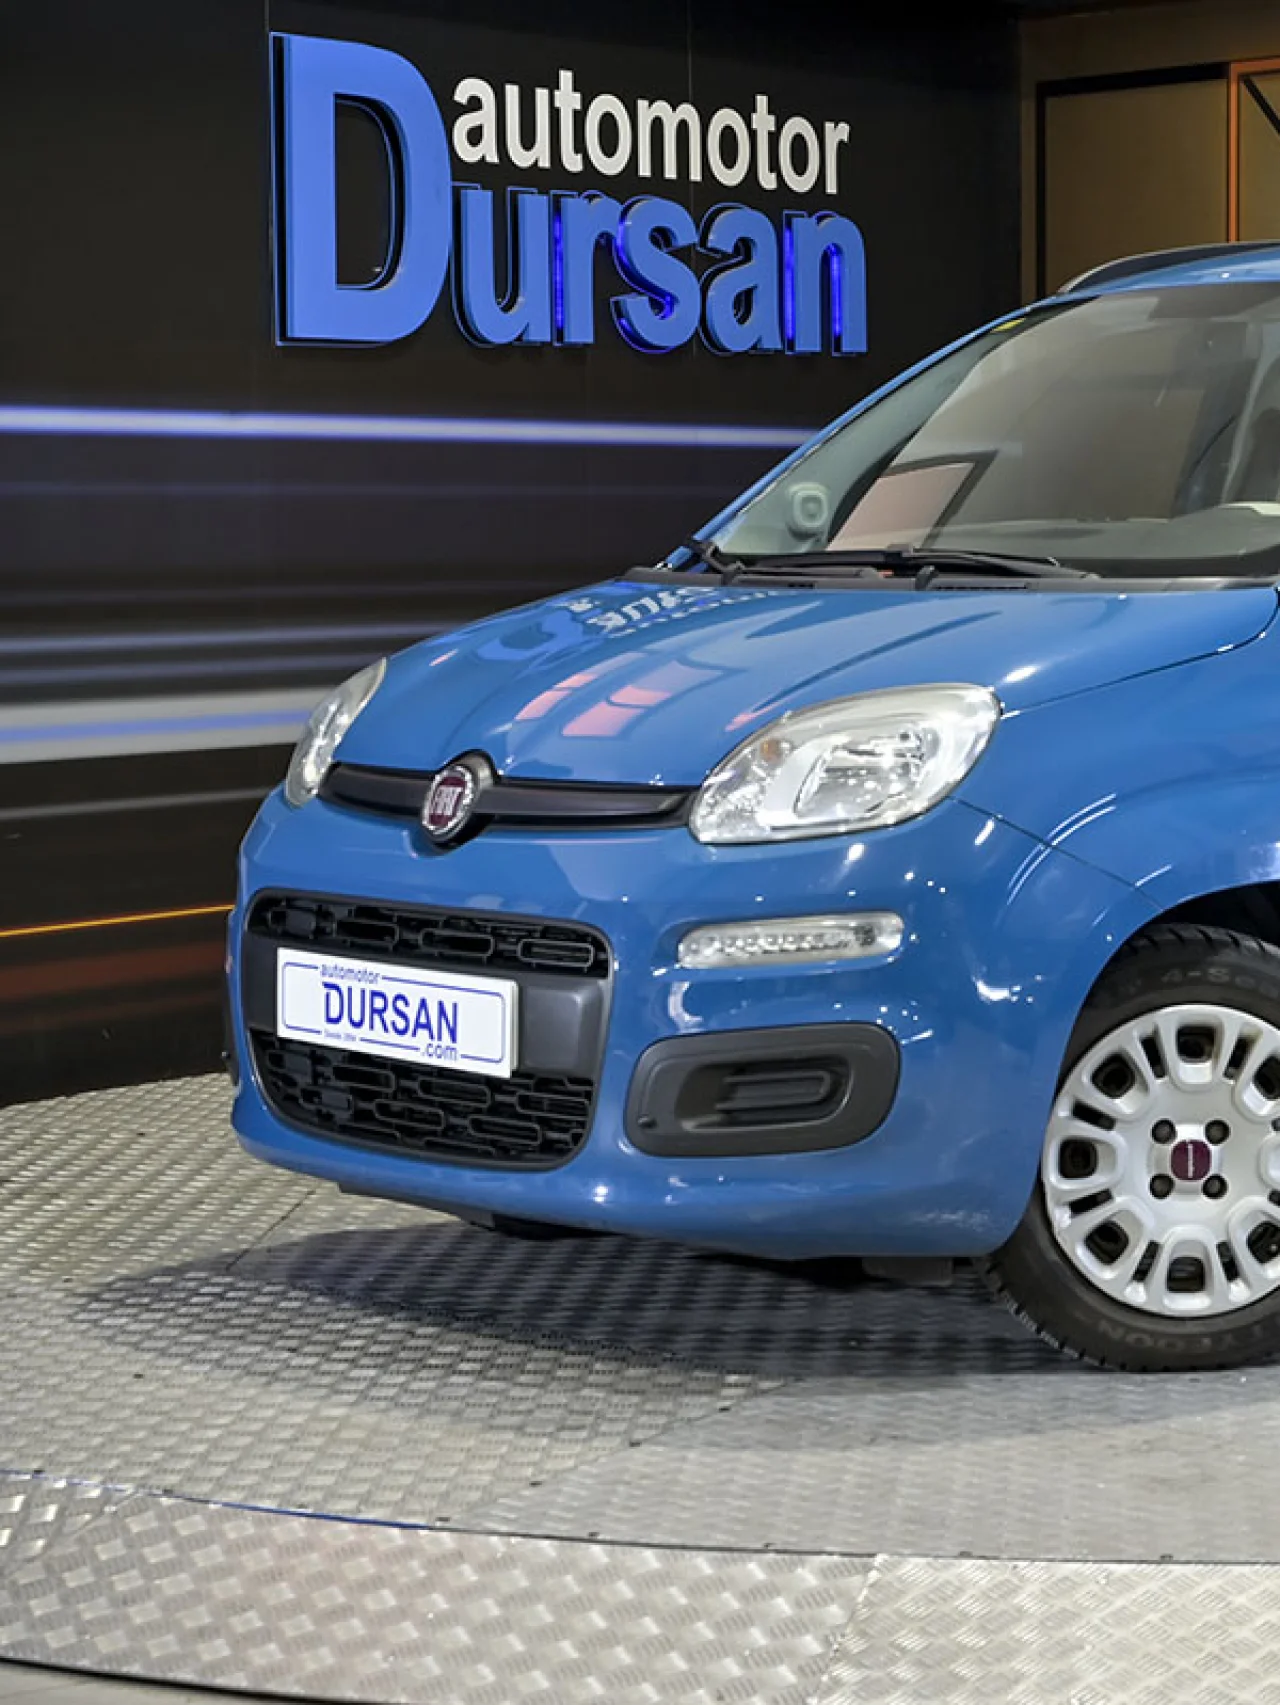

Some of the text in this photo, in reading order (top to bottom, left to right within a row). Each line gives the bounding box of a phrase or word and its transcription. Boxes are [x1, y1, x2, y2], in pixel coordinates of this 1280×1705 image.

[452, 68, 850, 196] automotor
[269, 31, 868, 356] Dursan
[320, 963, 380, 985] automotor
[322, 981, 458, 1044] DURSAN
[420, 1042, 459, 1062] .com
